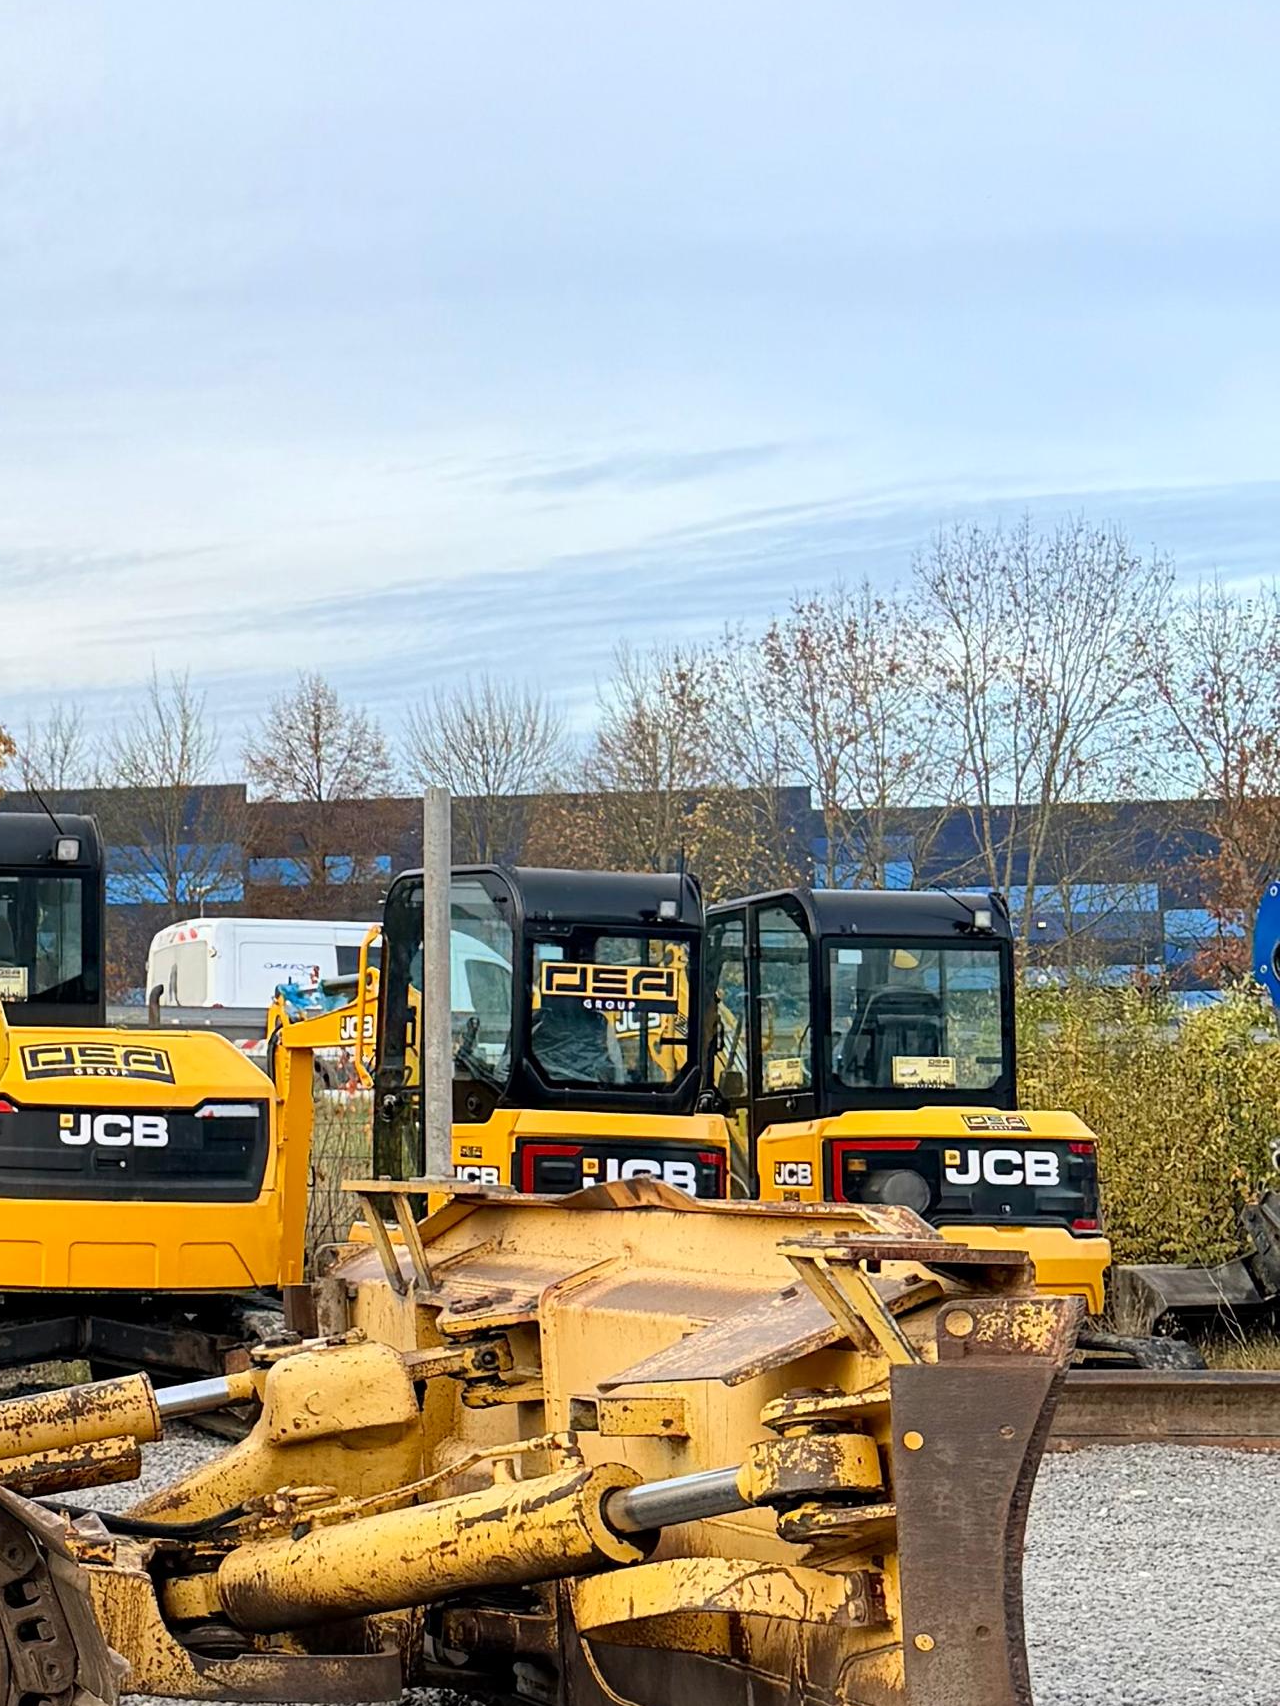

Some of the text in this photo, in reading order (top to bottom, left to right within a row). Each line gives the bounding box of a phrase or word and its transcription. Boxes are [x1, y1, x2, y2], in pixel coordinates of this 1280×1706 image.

[583, 998, 637, 1010] GROUP
[340, 1014, 374, 1040] JCB
[73, 1067, 130, 1077] GROUP
[59, 1113, 169, 1148] JCB
[582, 1157, 698, 1197] JCB
[774, 1162, 813, 1186] JCB
[944, 1149, 1060, 1186] JCB
